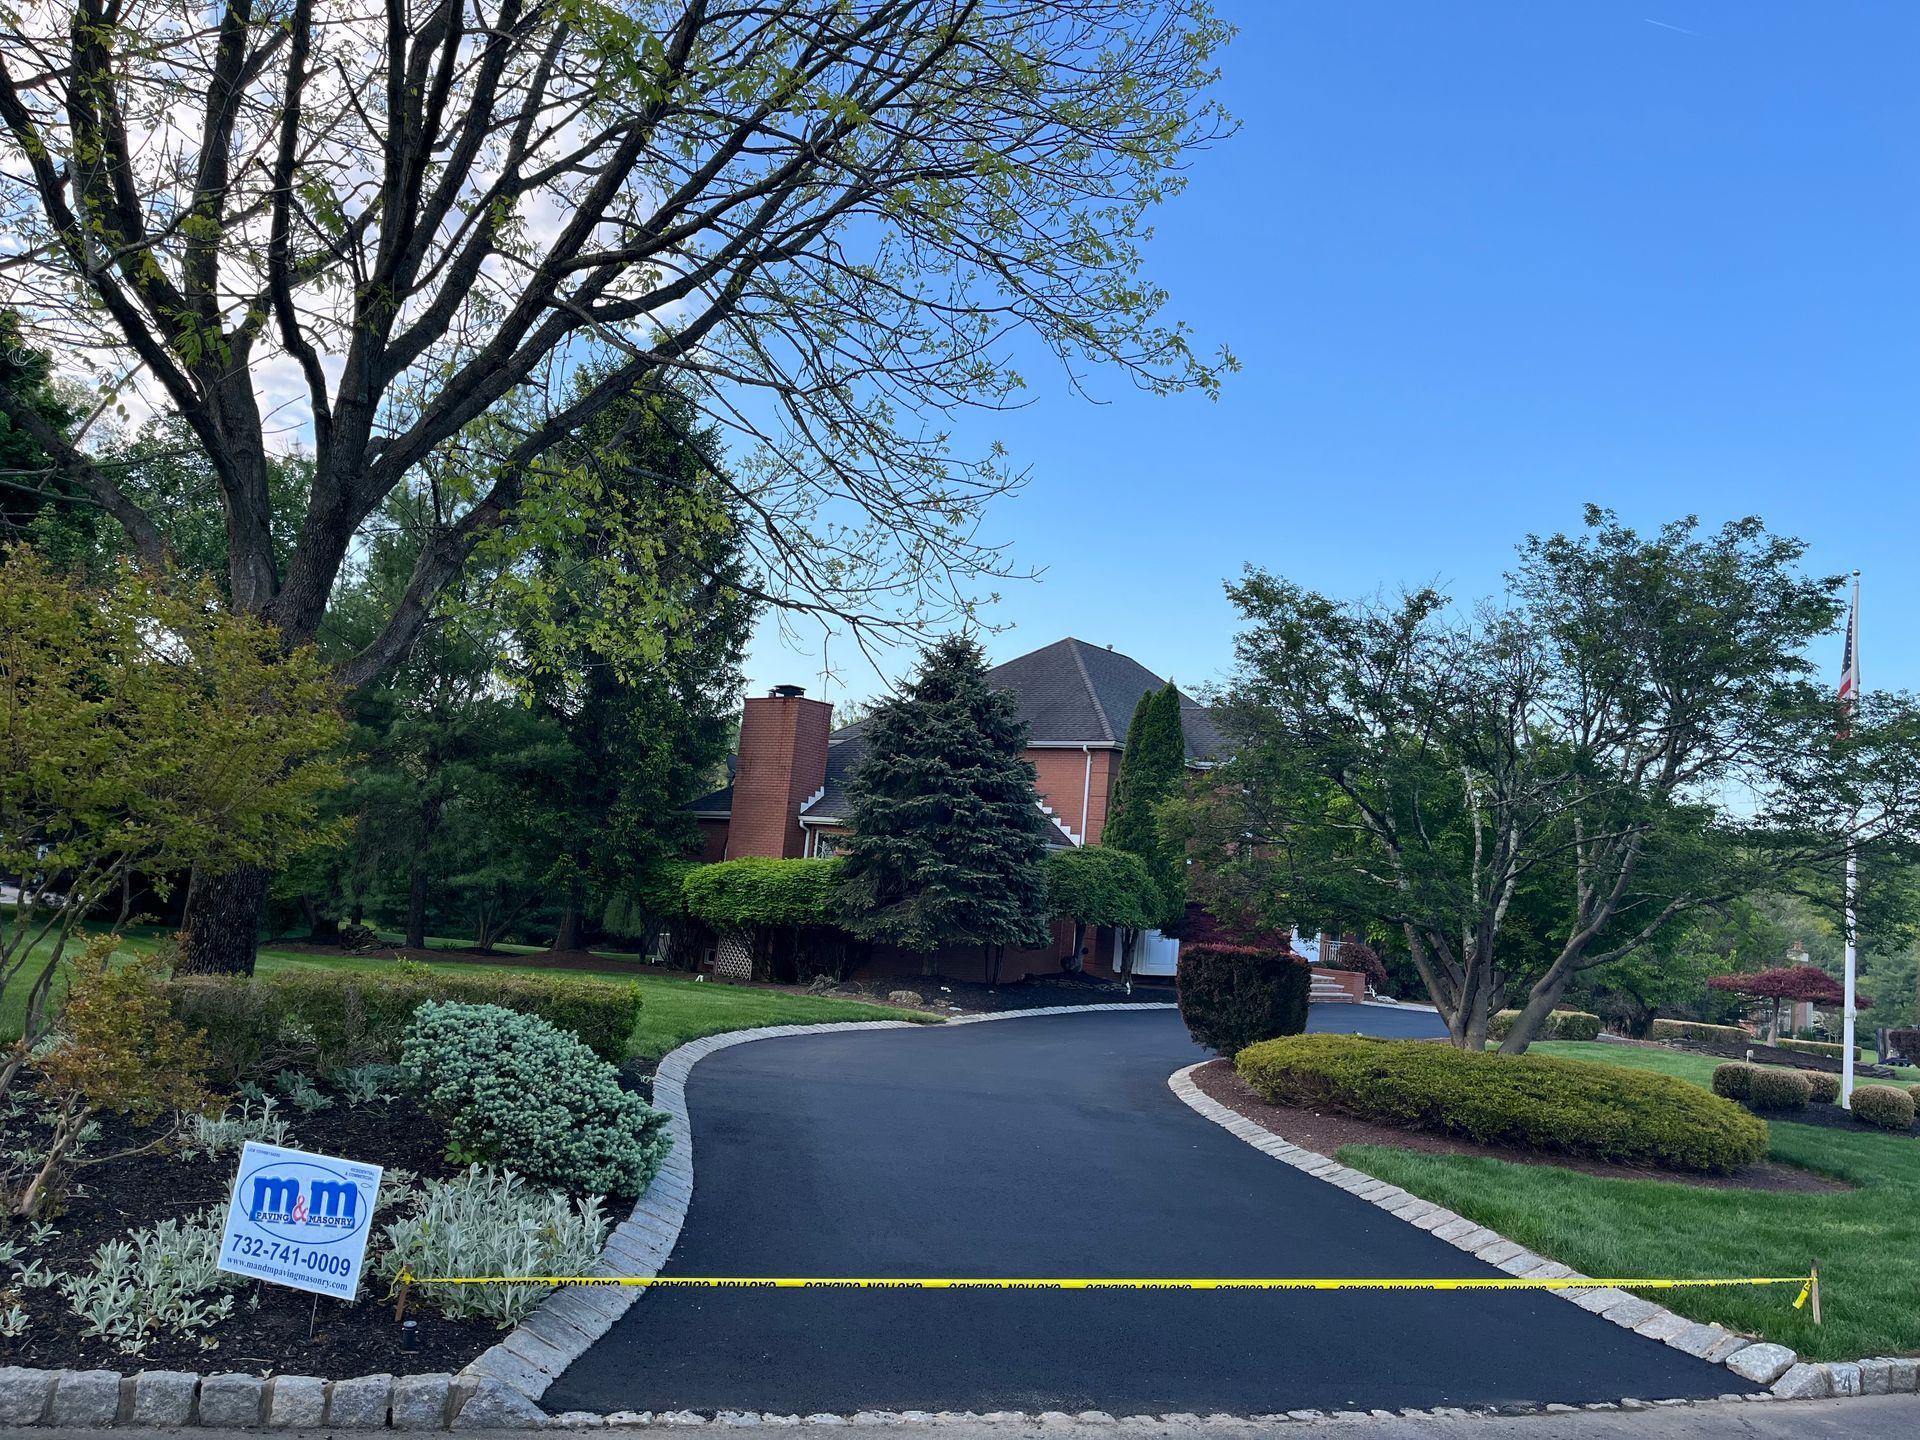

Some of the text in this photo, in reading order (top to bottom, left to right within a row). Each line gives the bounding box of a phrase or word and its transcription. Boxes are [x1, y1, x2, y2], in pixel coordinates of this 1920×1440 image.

[256, 1212, 353, 1226] PAVING MASONRY
[232, 1234, 351, 1277] 732-741-0009
[227, 1257, 348, 1291] www.mandmpavingmasonry.com
